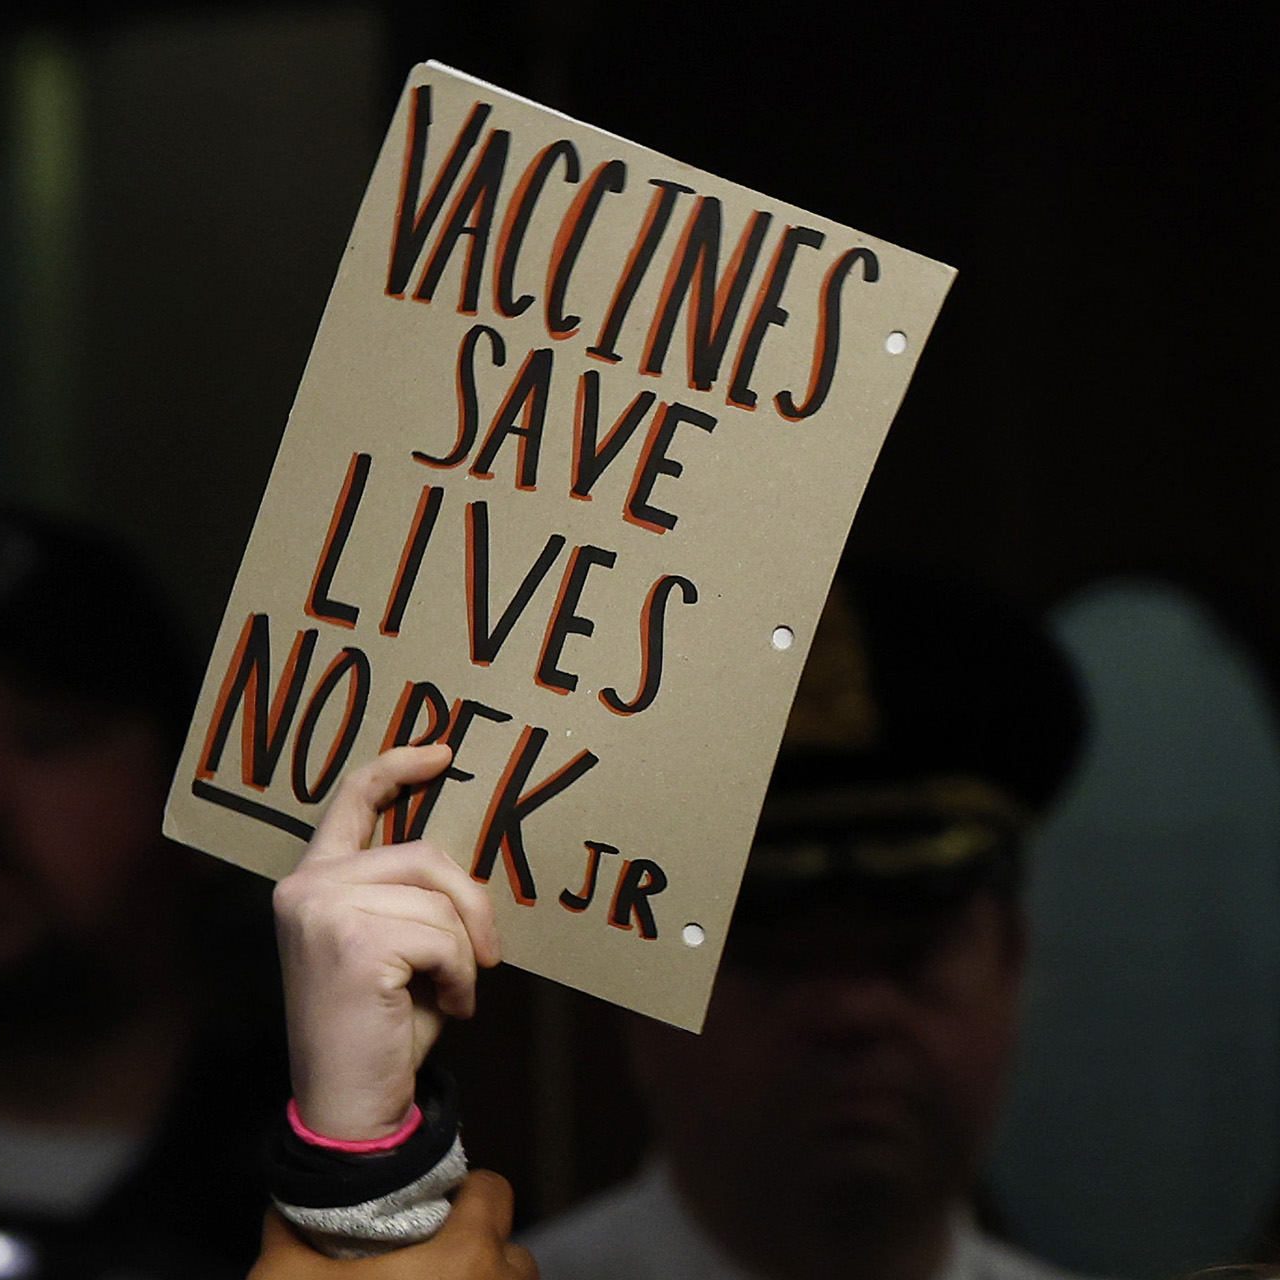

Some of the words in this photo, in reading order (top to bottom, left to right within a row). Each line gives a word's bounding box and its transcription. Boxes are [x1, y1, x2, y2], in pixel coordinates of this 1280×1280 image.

[384, 85, 880, 421] VACCINES
[413, 325, 717, 534] SAVE
[305, 453, 698, 716] LIVES
[199, 612, 371, 804] NO
[377, 680, 599, 907] RFK
[559, 840, 668, 941] JR
